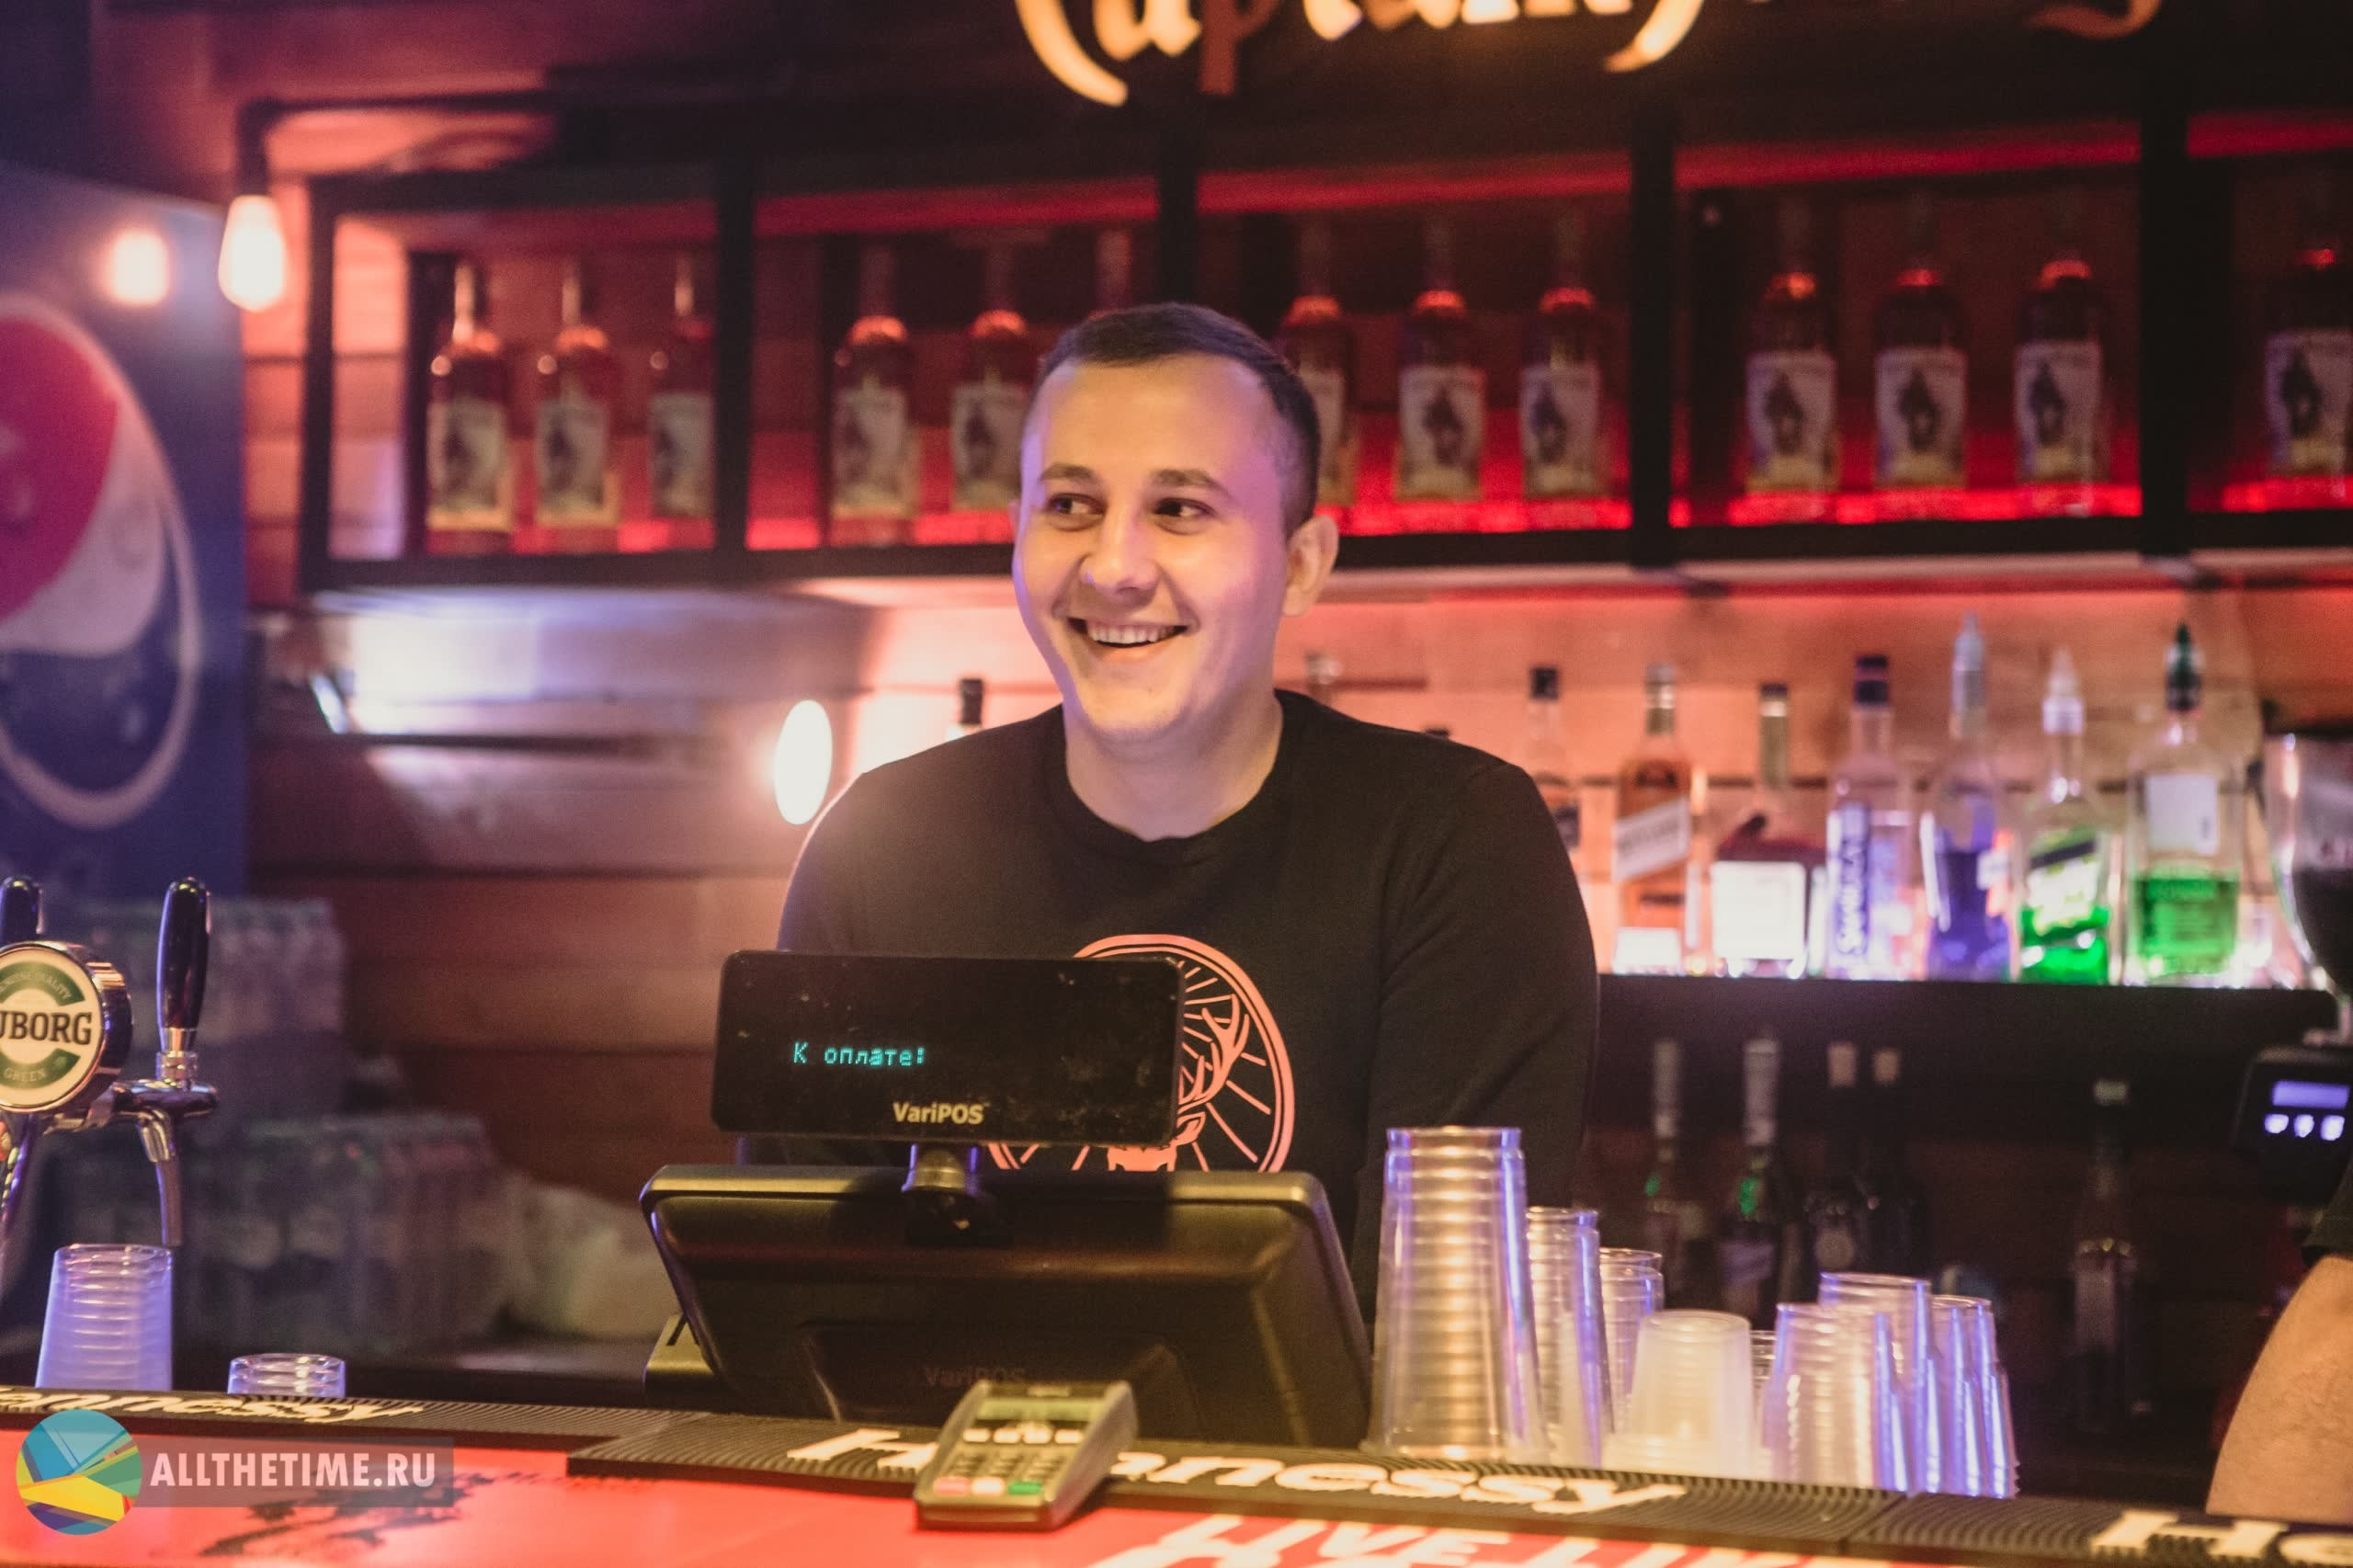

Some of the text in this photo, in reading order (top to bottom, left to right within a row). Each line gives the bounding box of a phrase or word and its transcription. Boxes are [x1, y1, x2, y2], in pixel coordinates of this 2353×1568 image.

[792, 1041, 809, 1064] К
[892, 1102, 985, 1125] VariPOS
[0, 1386, 423, 1424] ennessy
[786, 1427, 1686, 1516] Hnessy
